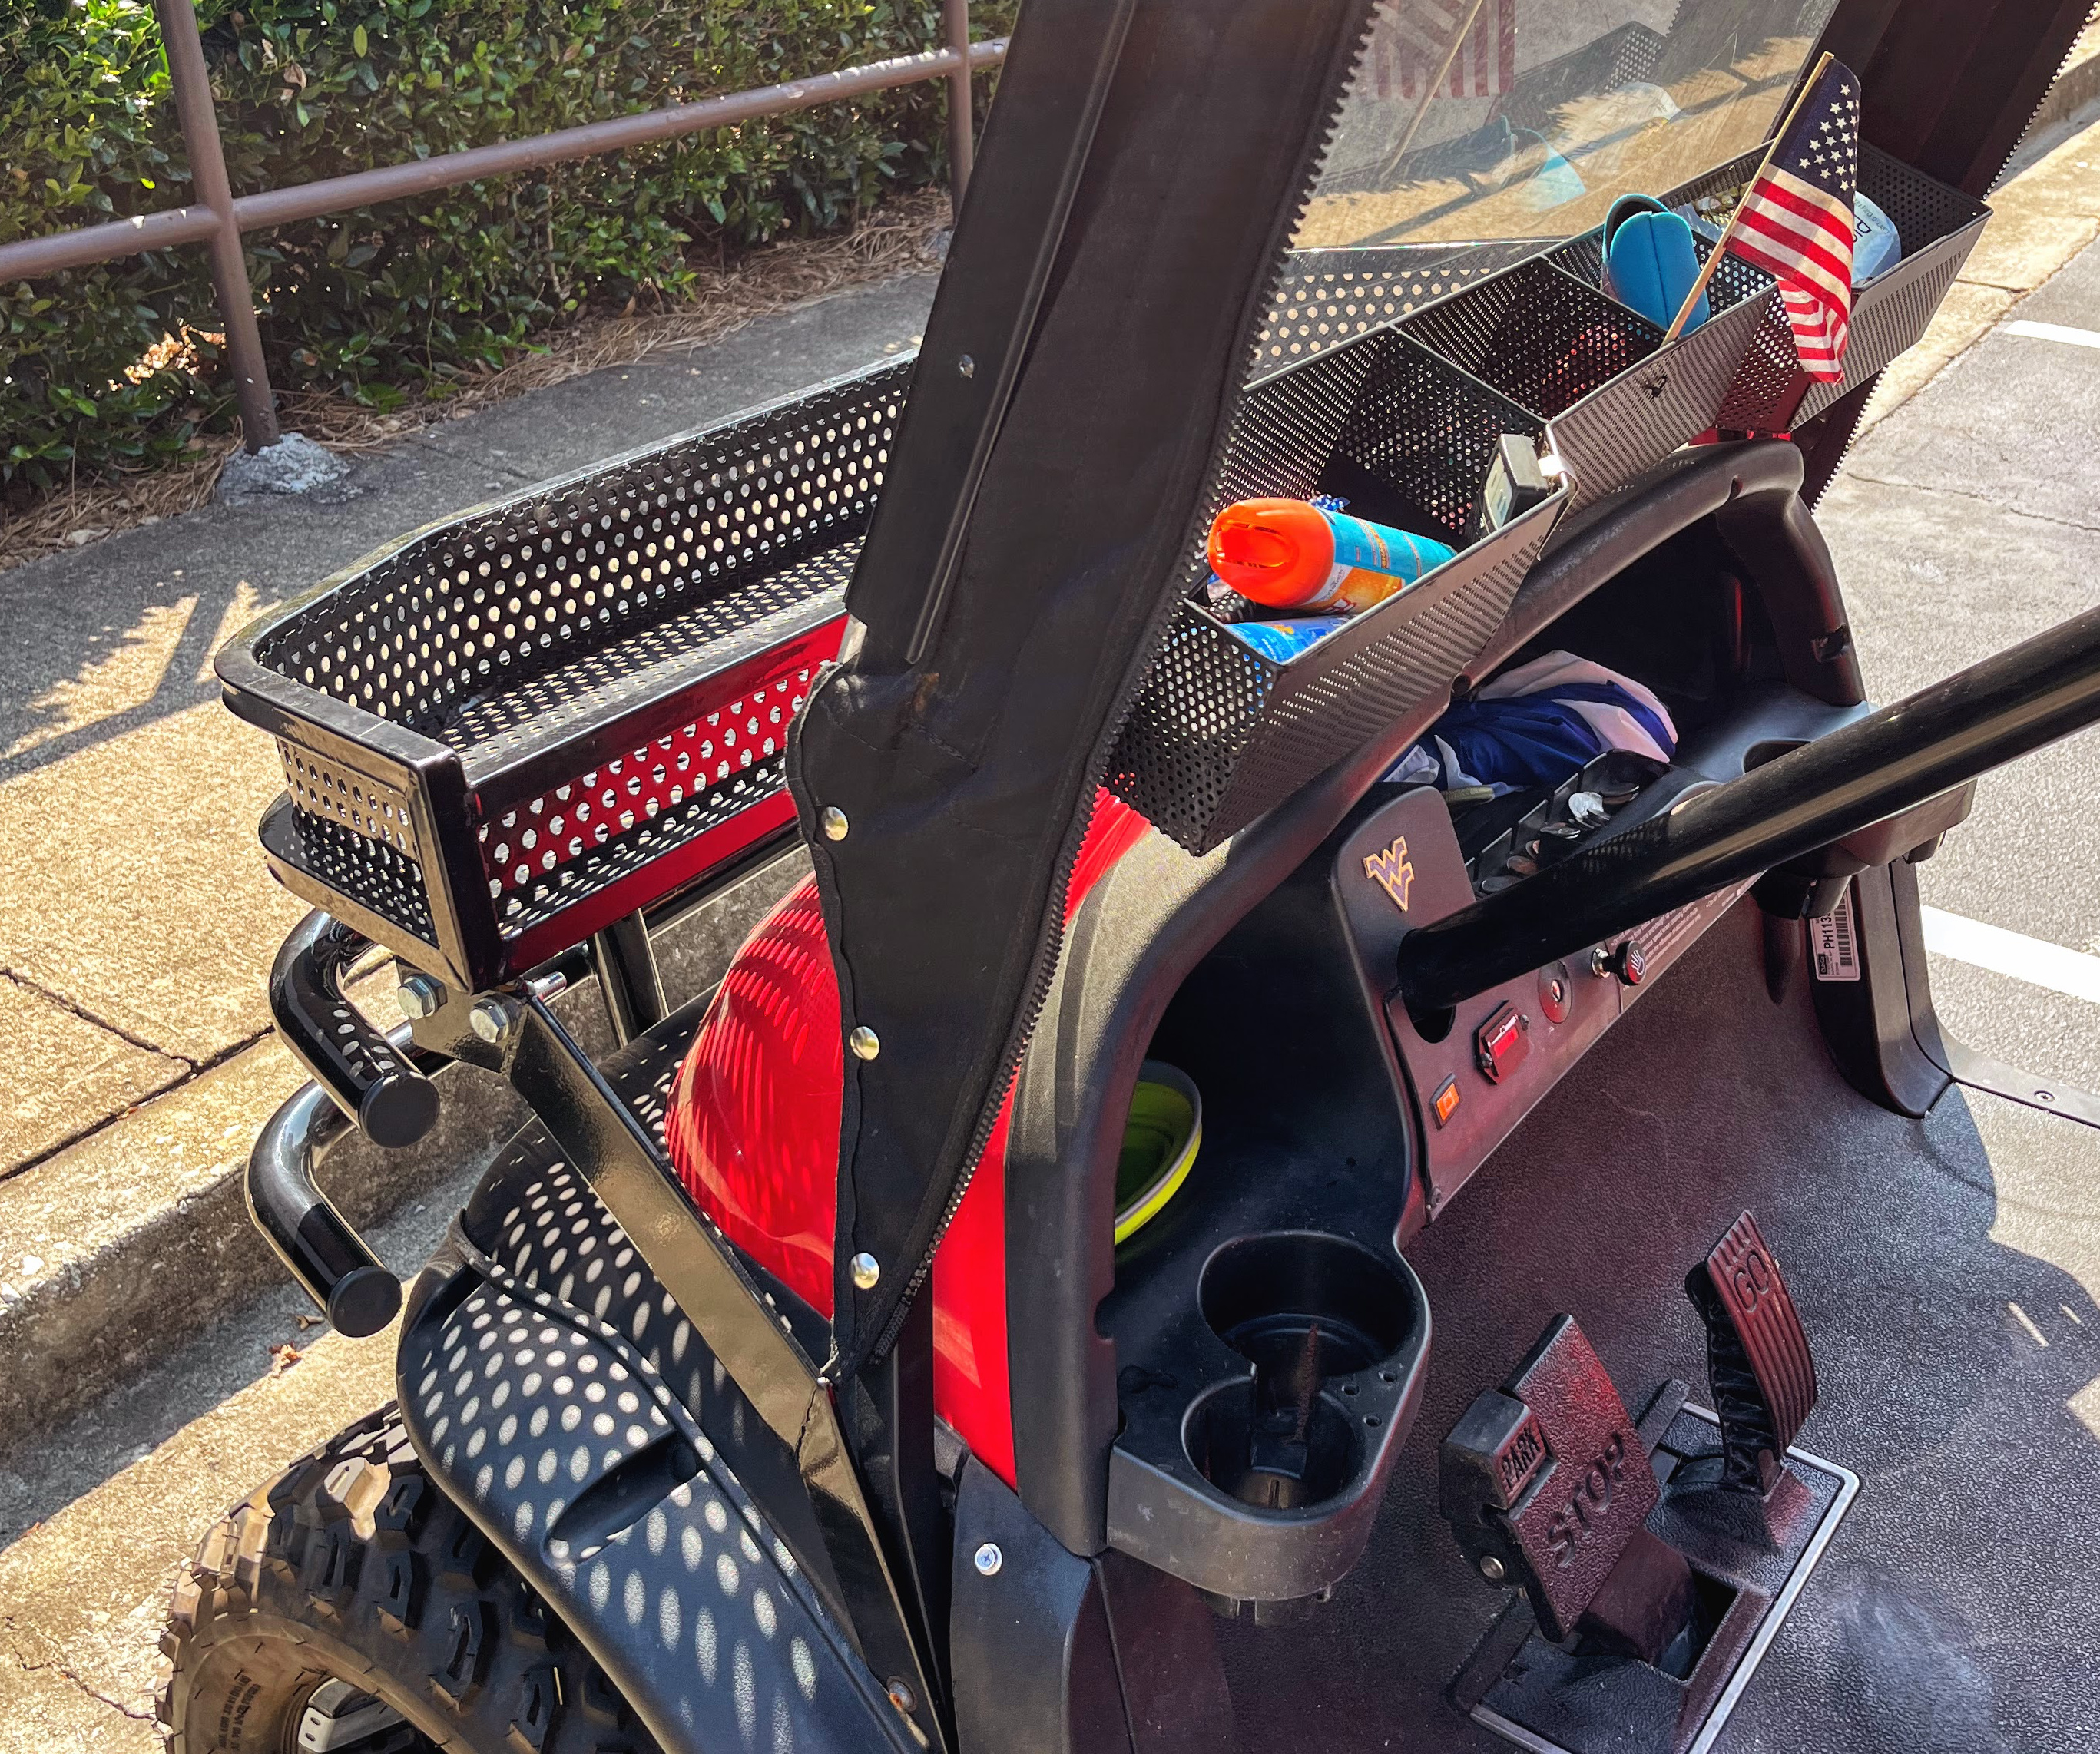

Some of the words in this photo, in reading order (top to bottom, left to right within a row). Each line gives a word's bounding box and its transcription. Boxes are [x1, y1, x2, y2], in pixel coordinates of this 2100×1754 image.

[1820, 912, 1835, 949] PH113
[1734, 1249, 1769, 1312] GO
[1501, 1424, 1541, 1491] PARK
[1548, 1430, 1625, 1567] STOP
